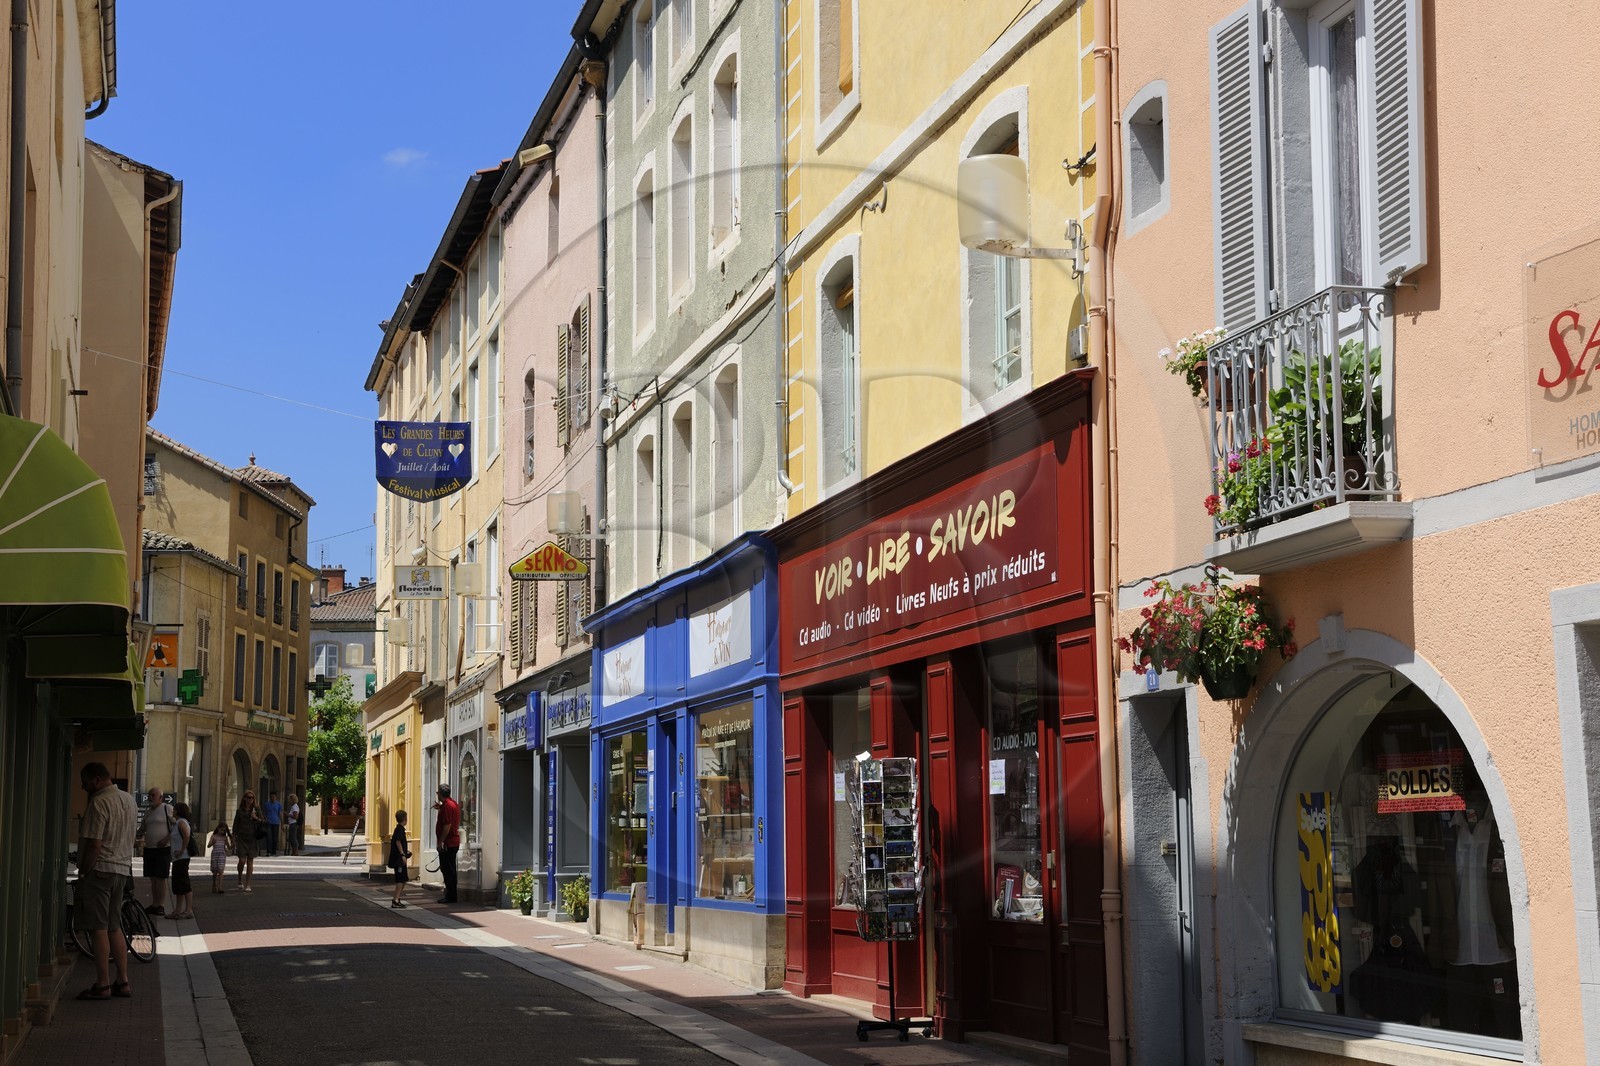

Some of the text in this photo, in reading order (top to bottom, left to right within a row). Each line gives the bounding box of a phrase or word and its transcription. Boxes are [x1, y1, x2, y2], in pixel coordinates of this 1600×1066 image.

[382, 425, 465, 440] LES GRANDES HEURES
[403, 443, 443, 457] DE CLUNY
[396, 462, 422, 473] Juillet
[430, 462, 450, 472] Août
[388, 478, 461, 499] Festival Musical
[815, 489, 1016, 604] VOIR LIRE SAVOIR
[524, 546, 577, 571] SERMO
[799, 628, 808, 646] Cd
[811, 621, 831, 642] audio
[844, 613, 854, 631] Cd
[857, 603, 880, 626] vidéo
[896, 591, 925, 614] Livres
[929, 577, 959, 604] Neufs
[963, 572, 970, 593] à
[974, 565, 997, 596] prix
[1002, 549, 1046, 581] réduits
[993, 731, 1037, 751] CD AUDIO DVD
[1388, 767, 1451, 796] SOLDES
[1301, 808, 1328, 832] Soldes
